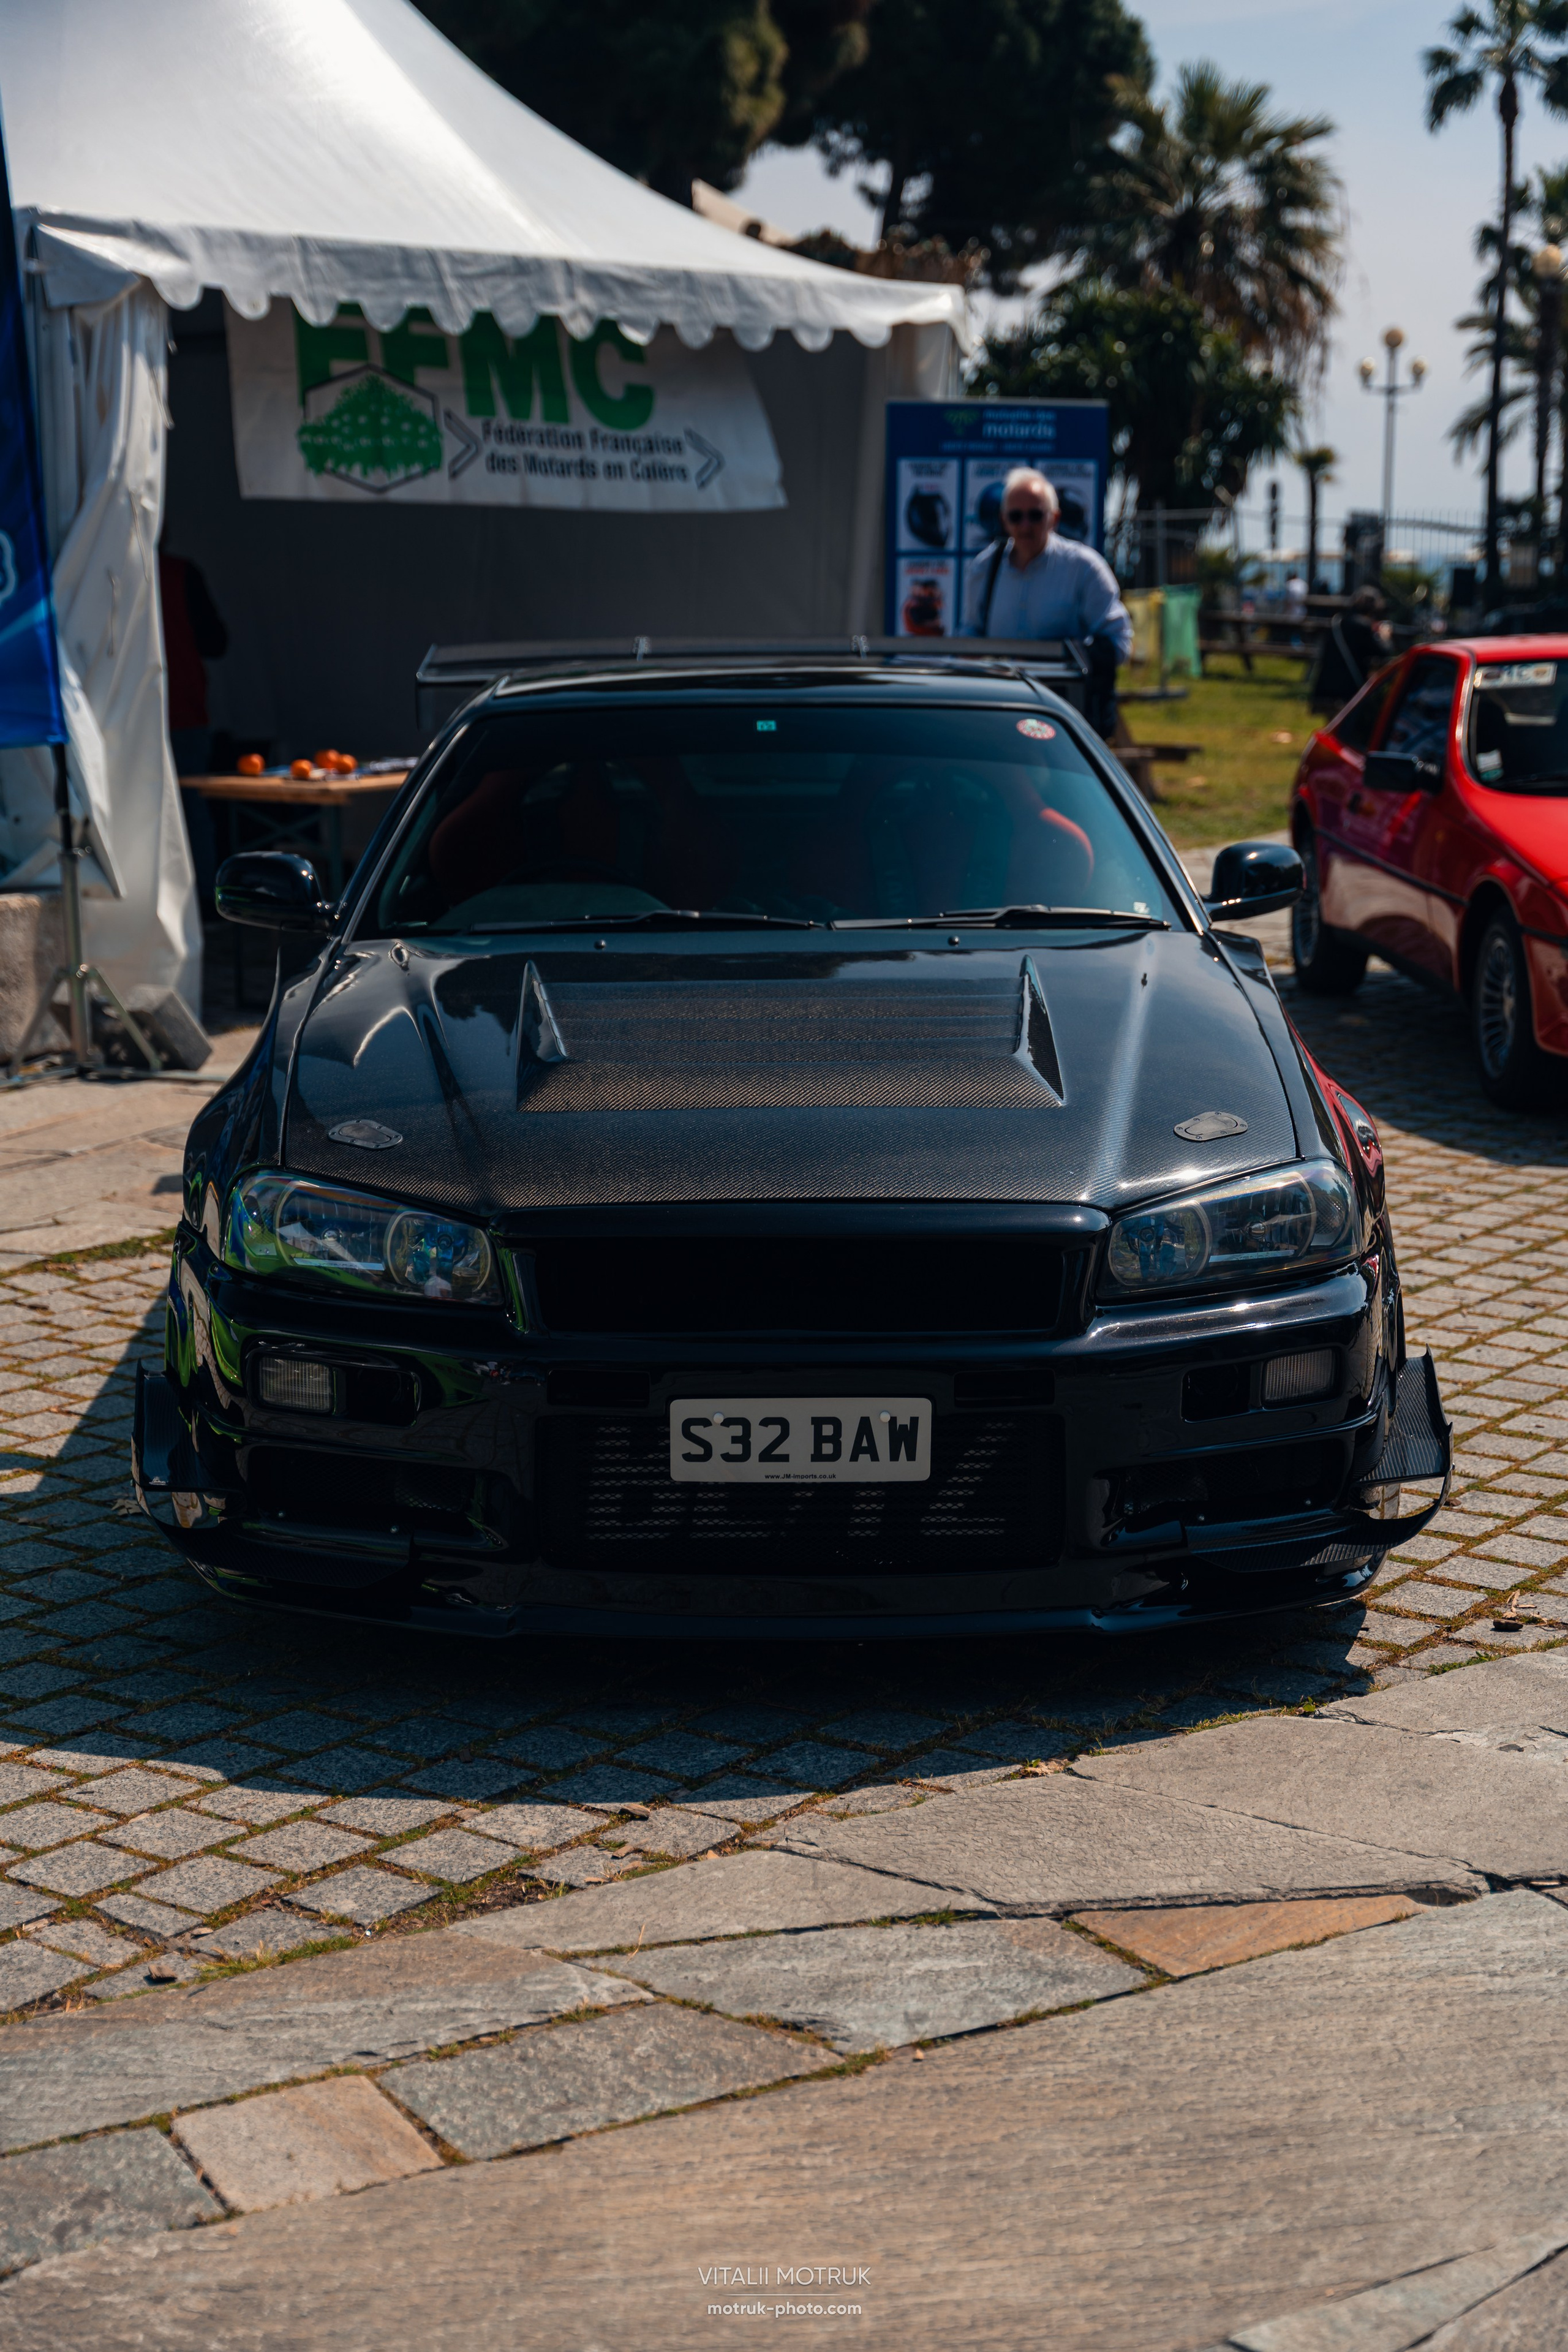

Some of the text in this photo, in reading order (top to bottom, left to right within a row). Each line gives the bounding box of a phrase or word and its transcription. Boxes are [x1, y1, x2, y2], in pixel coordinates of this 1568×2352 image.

[296, 304, 655, 431] FFMC
[481, 418, 686, 459] Fédération Française
[485, 448, 690, 483] des Motards en Colère
[681, 1416, 919, 1463] S32 BAW
